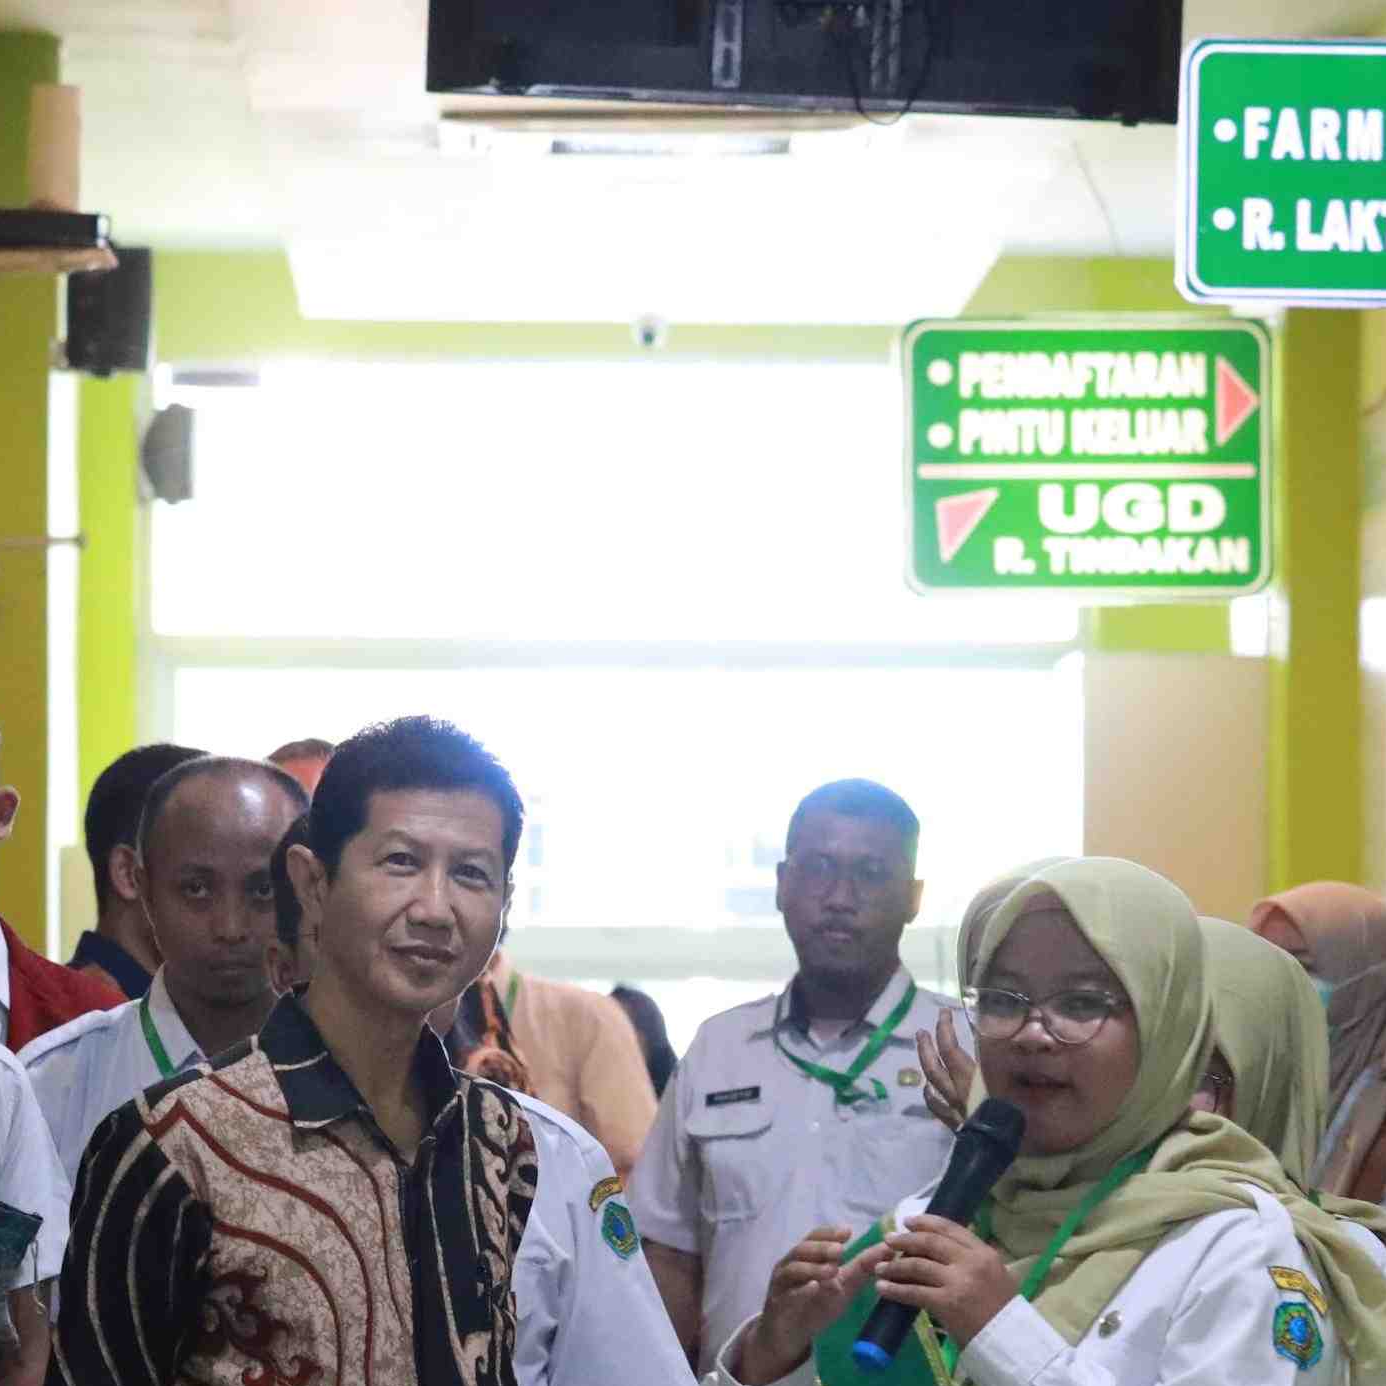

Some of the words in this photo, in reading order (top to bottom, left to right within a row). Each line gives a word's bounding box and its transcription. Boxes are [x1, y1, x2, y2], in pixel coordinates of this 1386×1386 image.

[1242, 197, 1286, 252] R.
[958, 351, 1208, 399] PENDAFTARAN
[958, 408, 1066, 455] PINTU
[1070, 408, 1209, 455] KELUAR
[1037, 482, 1227, 534] UGD
[992, 536, 1037, 575] R.
[1042, 536, 1250, 575] TINDAKAN
